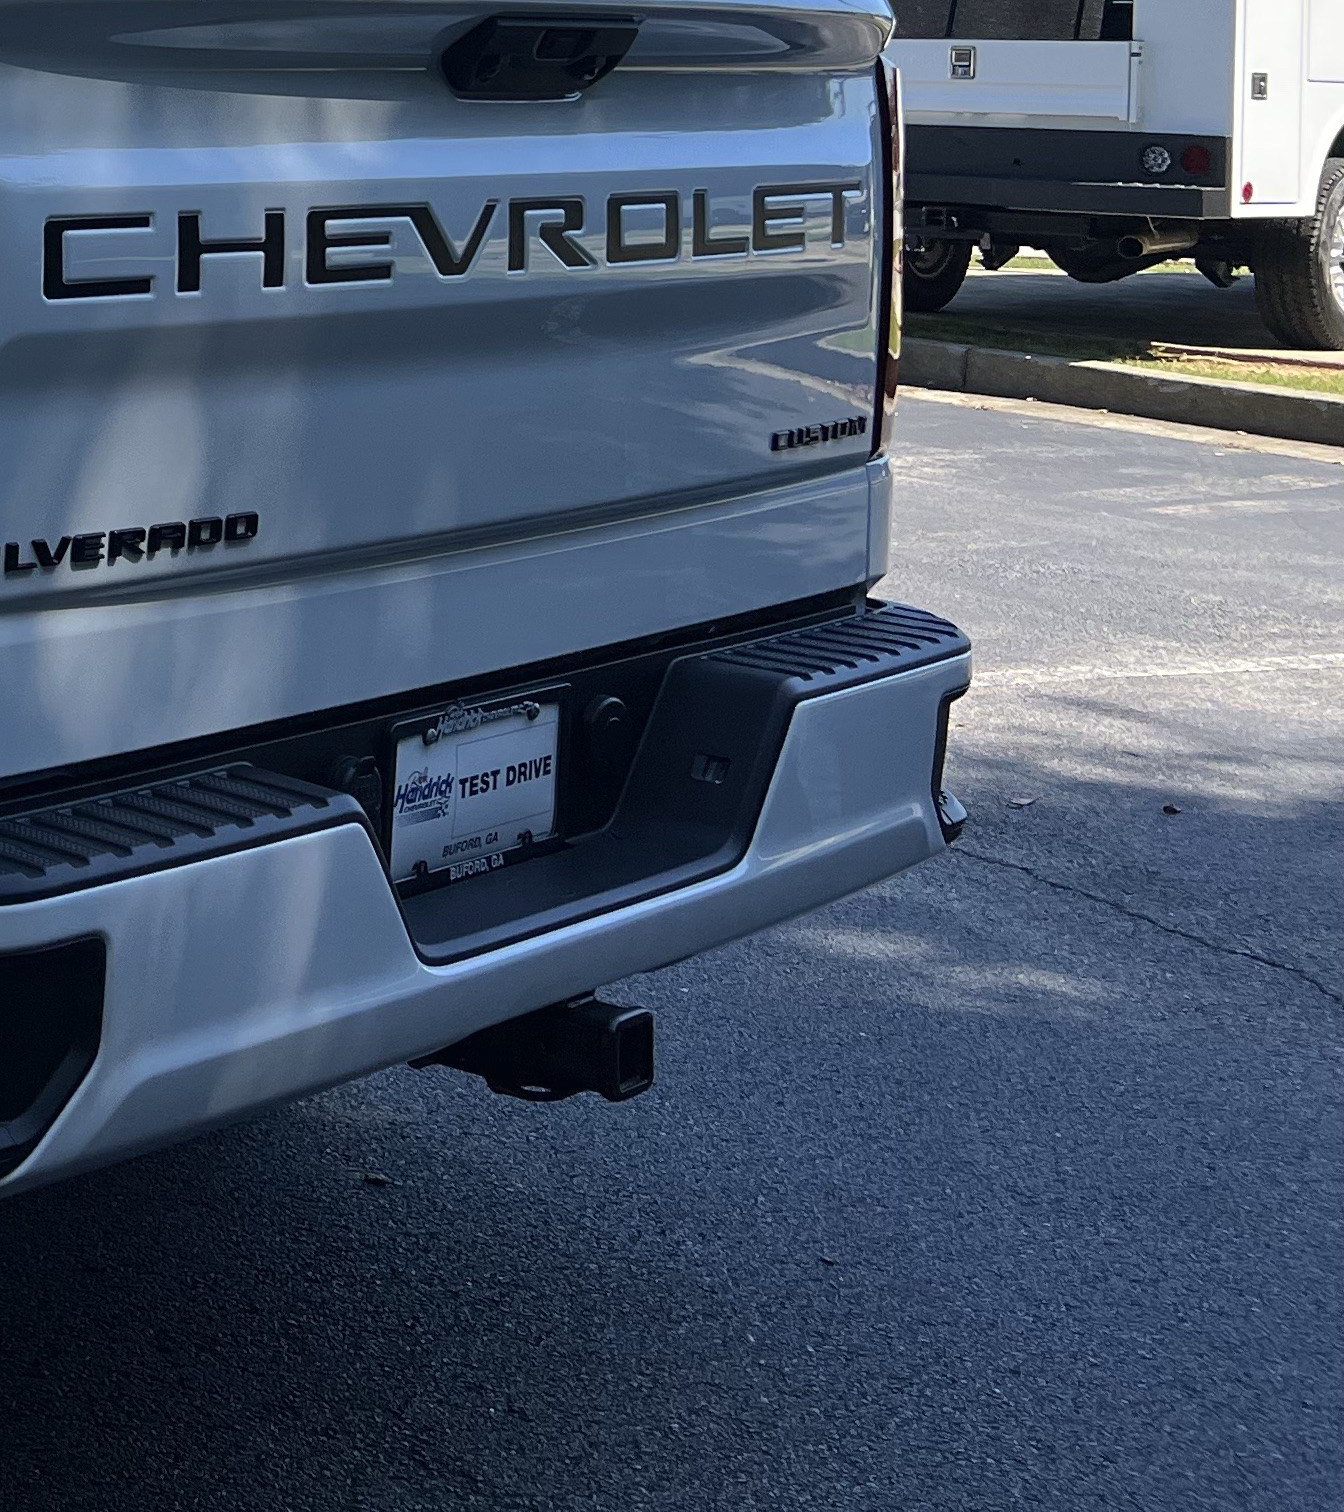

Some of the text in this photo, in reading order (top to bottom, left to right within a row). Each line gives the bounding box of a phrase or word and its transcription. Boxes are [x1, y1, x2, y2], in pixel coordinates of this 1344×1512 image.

[43, 181, 863, 303] CHEVROLET
[771, 416, 867, 452] CUSTOM
[393, 773, 454, 813] Hendrick
[458, 754, 553, 799] TEST DRIVE
[442, 831, 499, 857] BUFORD, GA
[450, 853, 505, 881] BUFORD, GA
